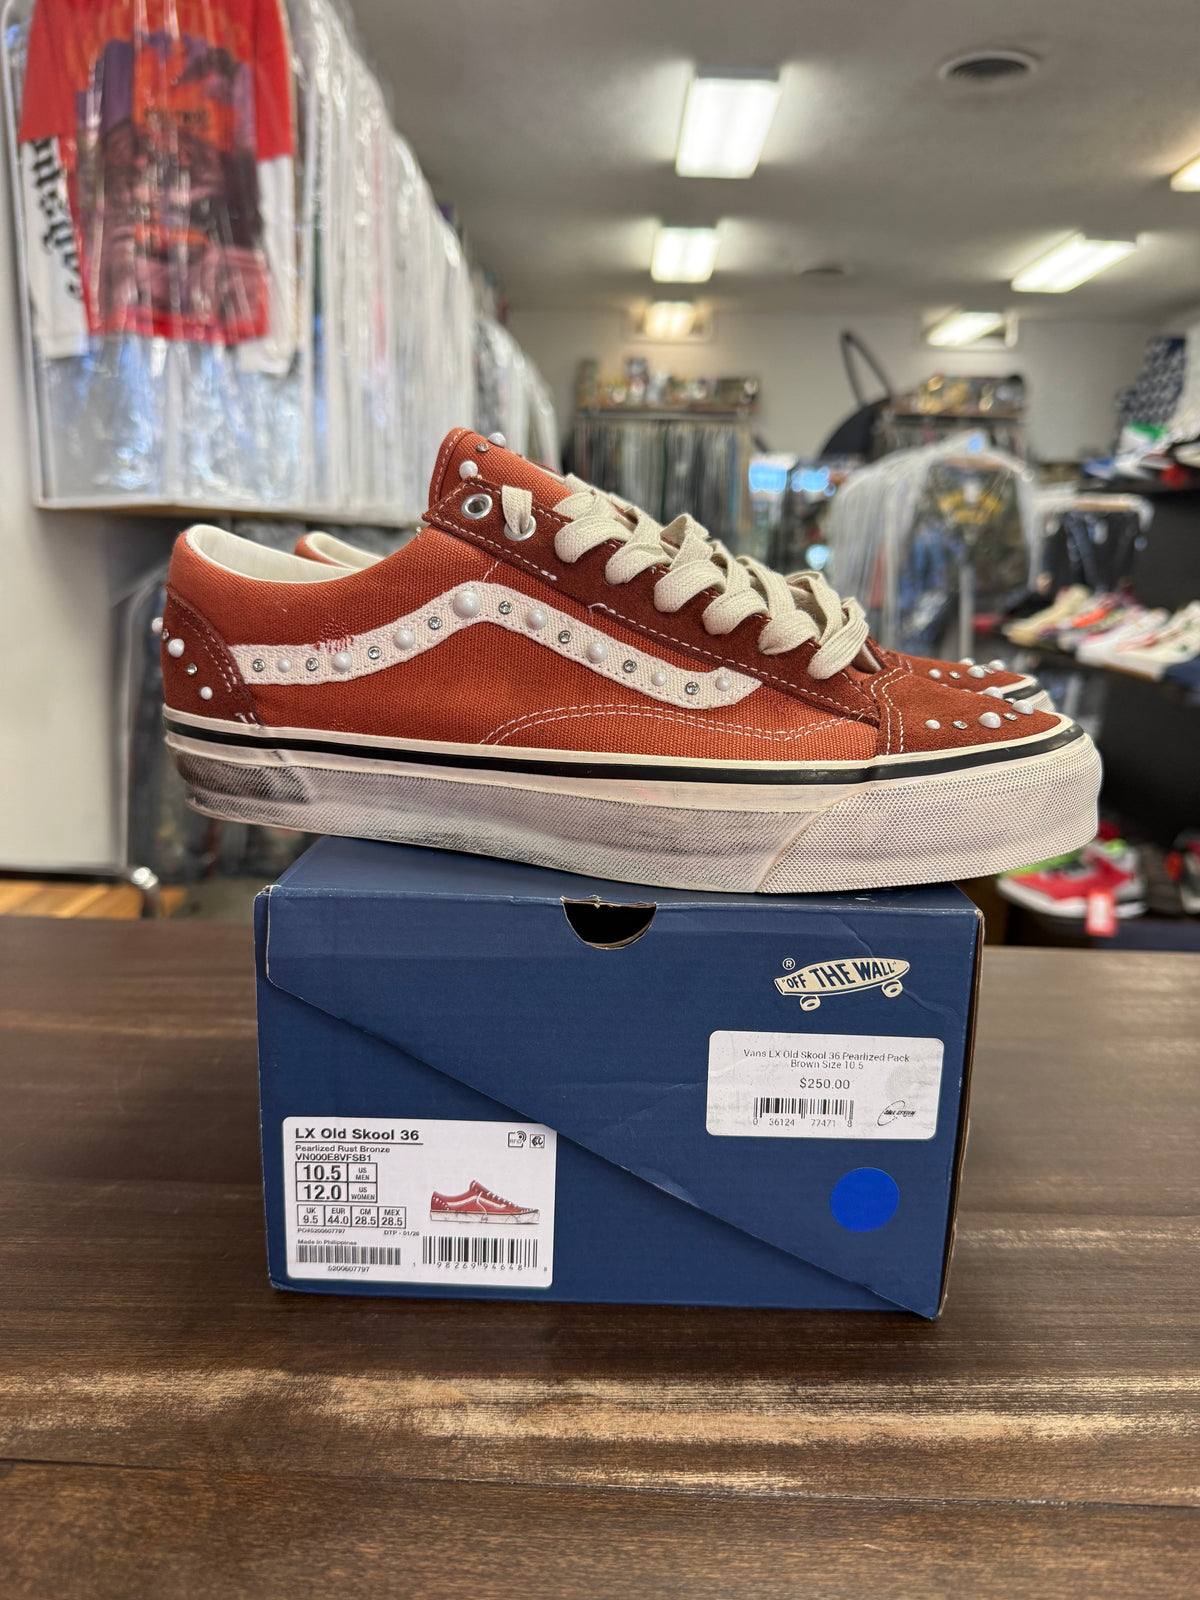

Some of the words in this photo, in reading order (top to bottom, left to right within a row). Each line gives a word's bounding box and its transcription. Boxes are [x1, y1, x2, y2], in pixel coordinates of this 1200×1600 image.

[808, 963, 856, 988] THE
[743, 1049, 766, 1058] Vans
[769, 1050, 781, 1058] LX
[783, 1050, 798, 1059] Old
[801, 1051, 826, 1060] Skool
[830, 1052, 840, 1060] 36
[842, 1052, 885, 1061] Pearlized
[887, 1054, 910, 1062] Pack
[791, 1060, 820, 1068] Brown
[822, 1060, 841, 1069] Size
[800, 1078, 850, 1089] $250.00
[295, 1128, 316, 1139] LX
[321, 1128, 346, 1139] Old
[352, 1129, 394, 1140] Skool
[400, 1130, 419, 1140] 36
[303, 1164, 341, 1180] 10.5
[304, 1184, 341, 1200] 12.0
[303, 1215, 318, 1224] 9.5
[328, 1216, 349, 1224] 44.0
[355, 1216, 376, 1225] 28.5
[381, 1217, 403, 1226] 28.5
